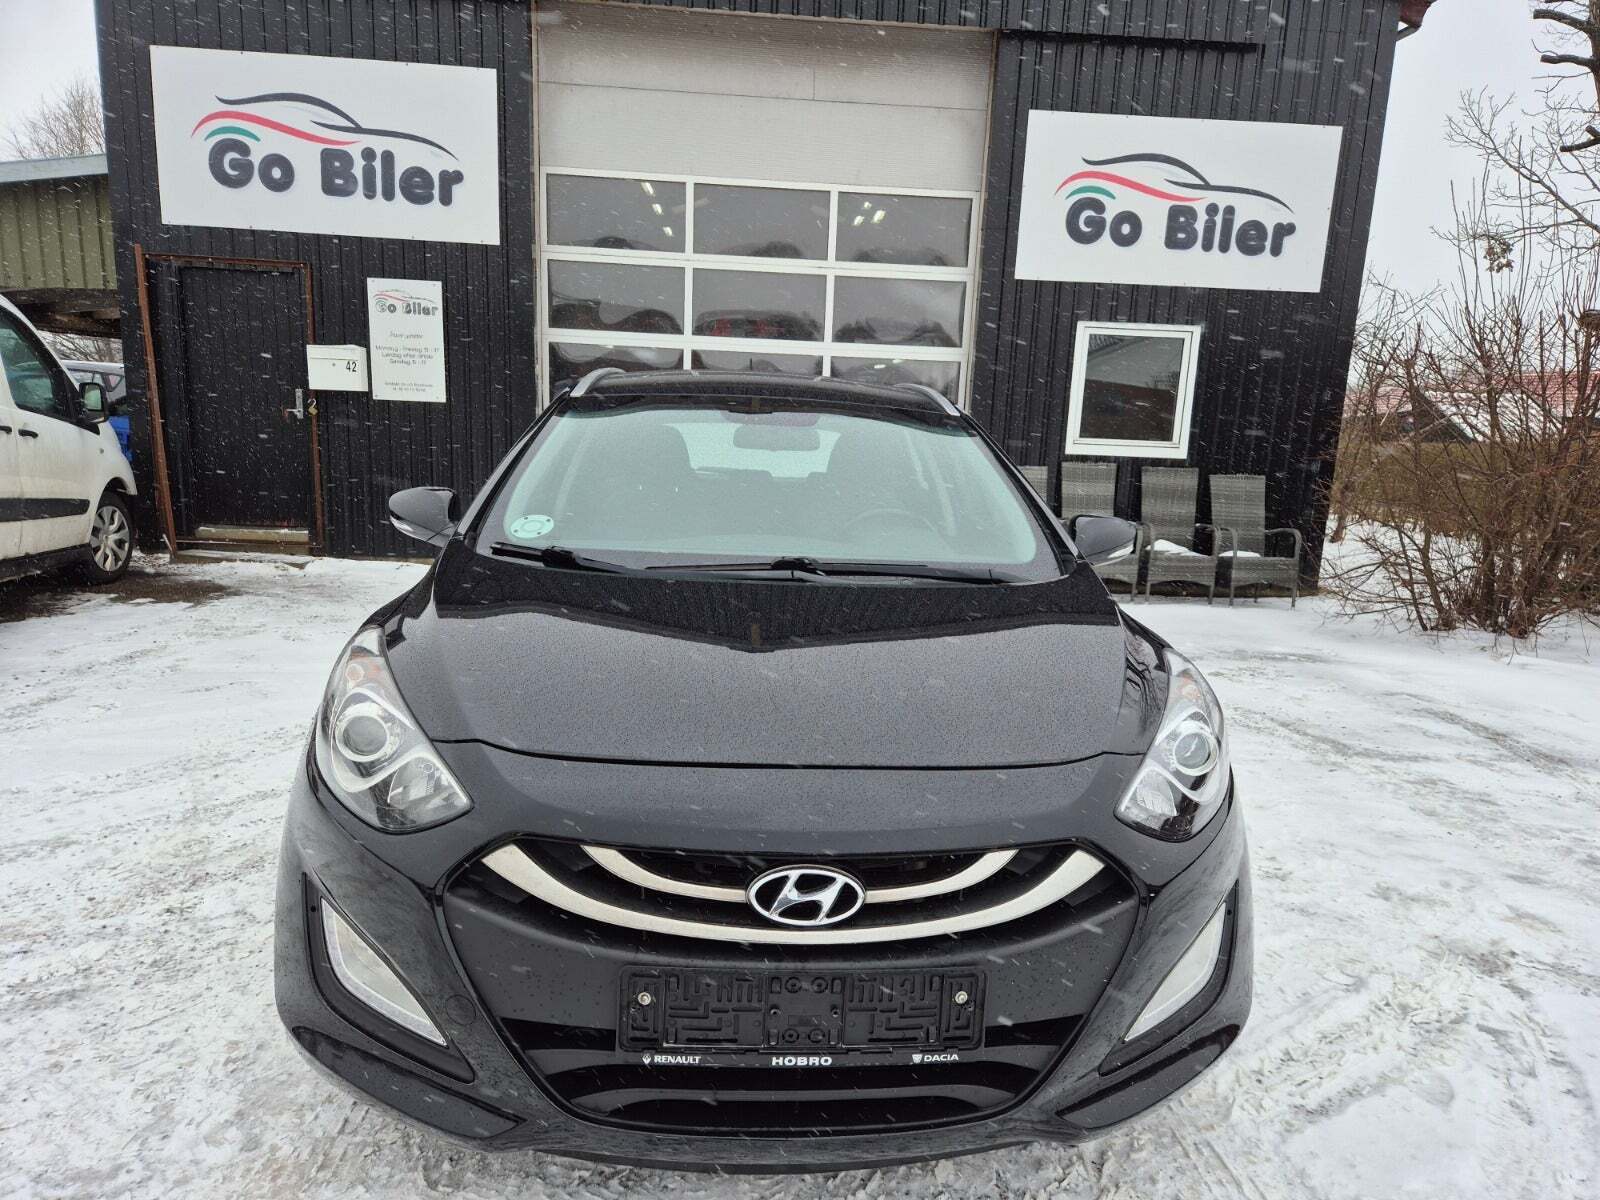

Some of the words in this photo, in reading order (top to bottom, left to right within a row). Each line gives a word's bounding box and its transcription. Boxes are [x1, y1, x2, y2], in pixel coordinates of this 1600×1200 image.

[208, 137, 296, 192] Go
[319, 146, 464, 207] Biler
[1065, 196, 1143, 247] Go
[1164, 202, 1297, 258] Biler
[345, 360, 357, 373] 42
[653, 1054, 702, 1065] RENAULT
[771, 1056, 833, 1067] HOBRO
[923, 1053, 960, 1063] DACIA
